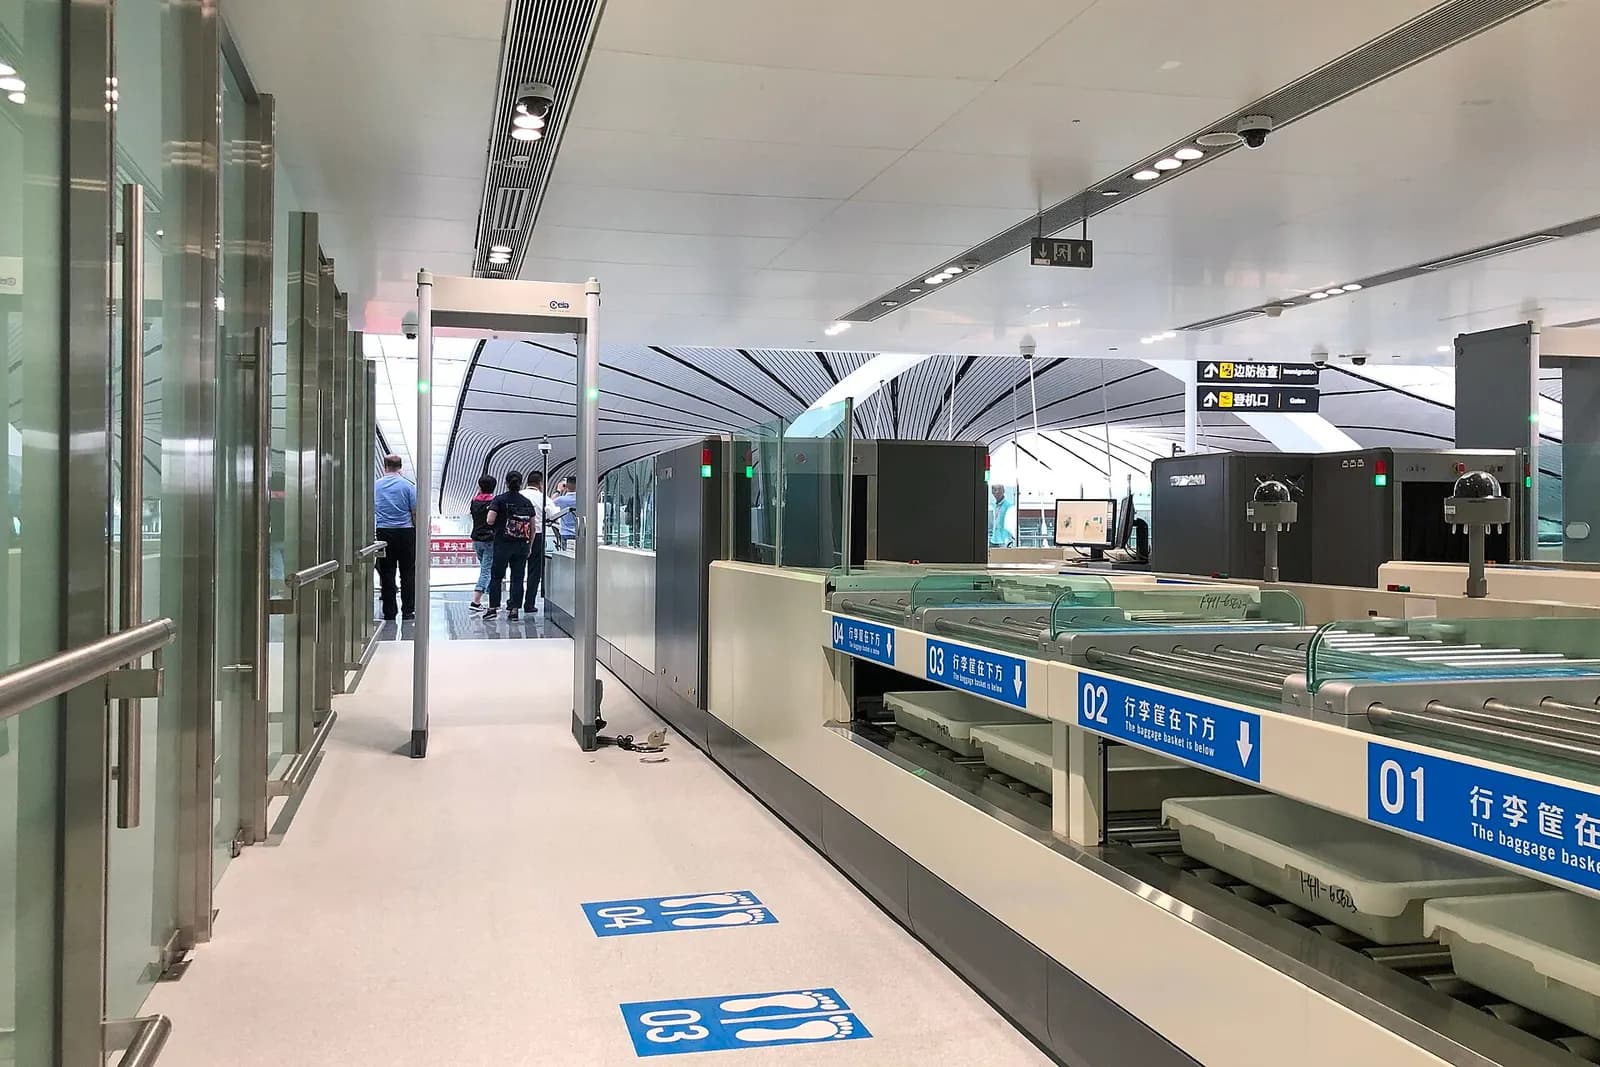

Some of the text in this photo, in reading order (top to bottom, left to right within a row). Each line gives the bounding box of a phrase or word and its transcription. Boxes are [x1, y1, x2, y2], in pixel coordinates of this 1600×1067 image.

[1234, 364, 1278, 378] 边防检查
[1283, 368, 1317, 376] Immigration
[1233, 393, 1269, 407] 登机口
[833, 621, 844, 645] 04
[929, 645, 944, 676] 03
[953, 653, 1003, 682] 行李筐在下方
[1083, 682, 1108, 725] 02
[1124, 696, 1216, 741] 行李筐在下方
[1125, 721, 1215, 757] The baggage basket is below
[1380, 759, 1424, 822] 01
[1469, 785, 1600, 850] 行李筐在
[1471, 822, 1494, 841] The
[1499, 830, 1556, 860] baggage
[597, 906, 653, 929] 04
[640, 1009, 710, 1043] 03
